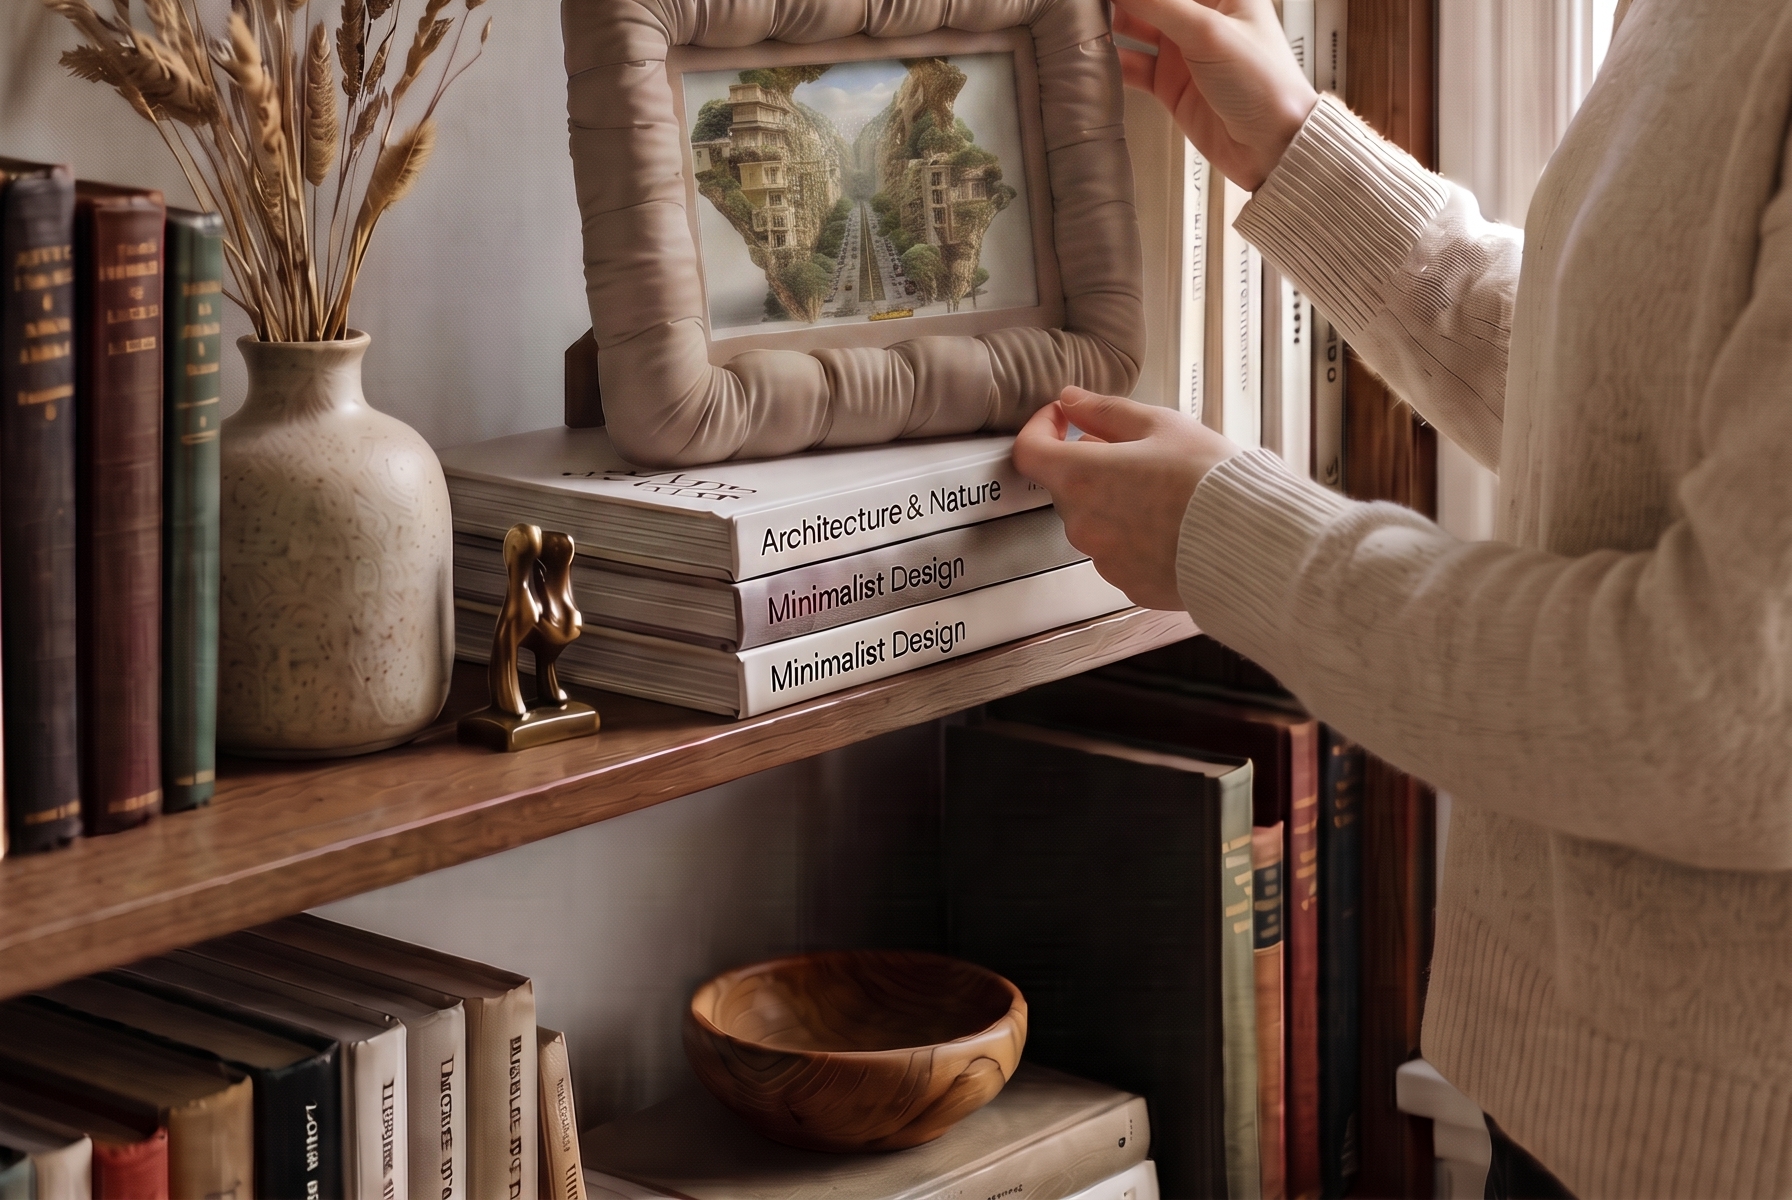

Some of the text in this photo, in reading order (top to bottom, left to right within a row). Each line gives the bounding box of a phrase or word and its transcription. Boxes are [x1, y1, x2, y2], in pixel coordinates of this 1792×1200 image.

[761, 480, 1001, 556] Architecture & Nature
[768, 556, 964, 624] Minimalist Design
[771, 621, 966, 692] Minimalist Design
